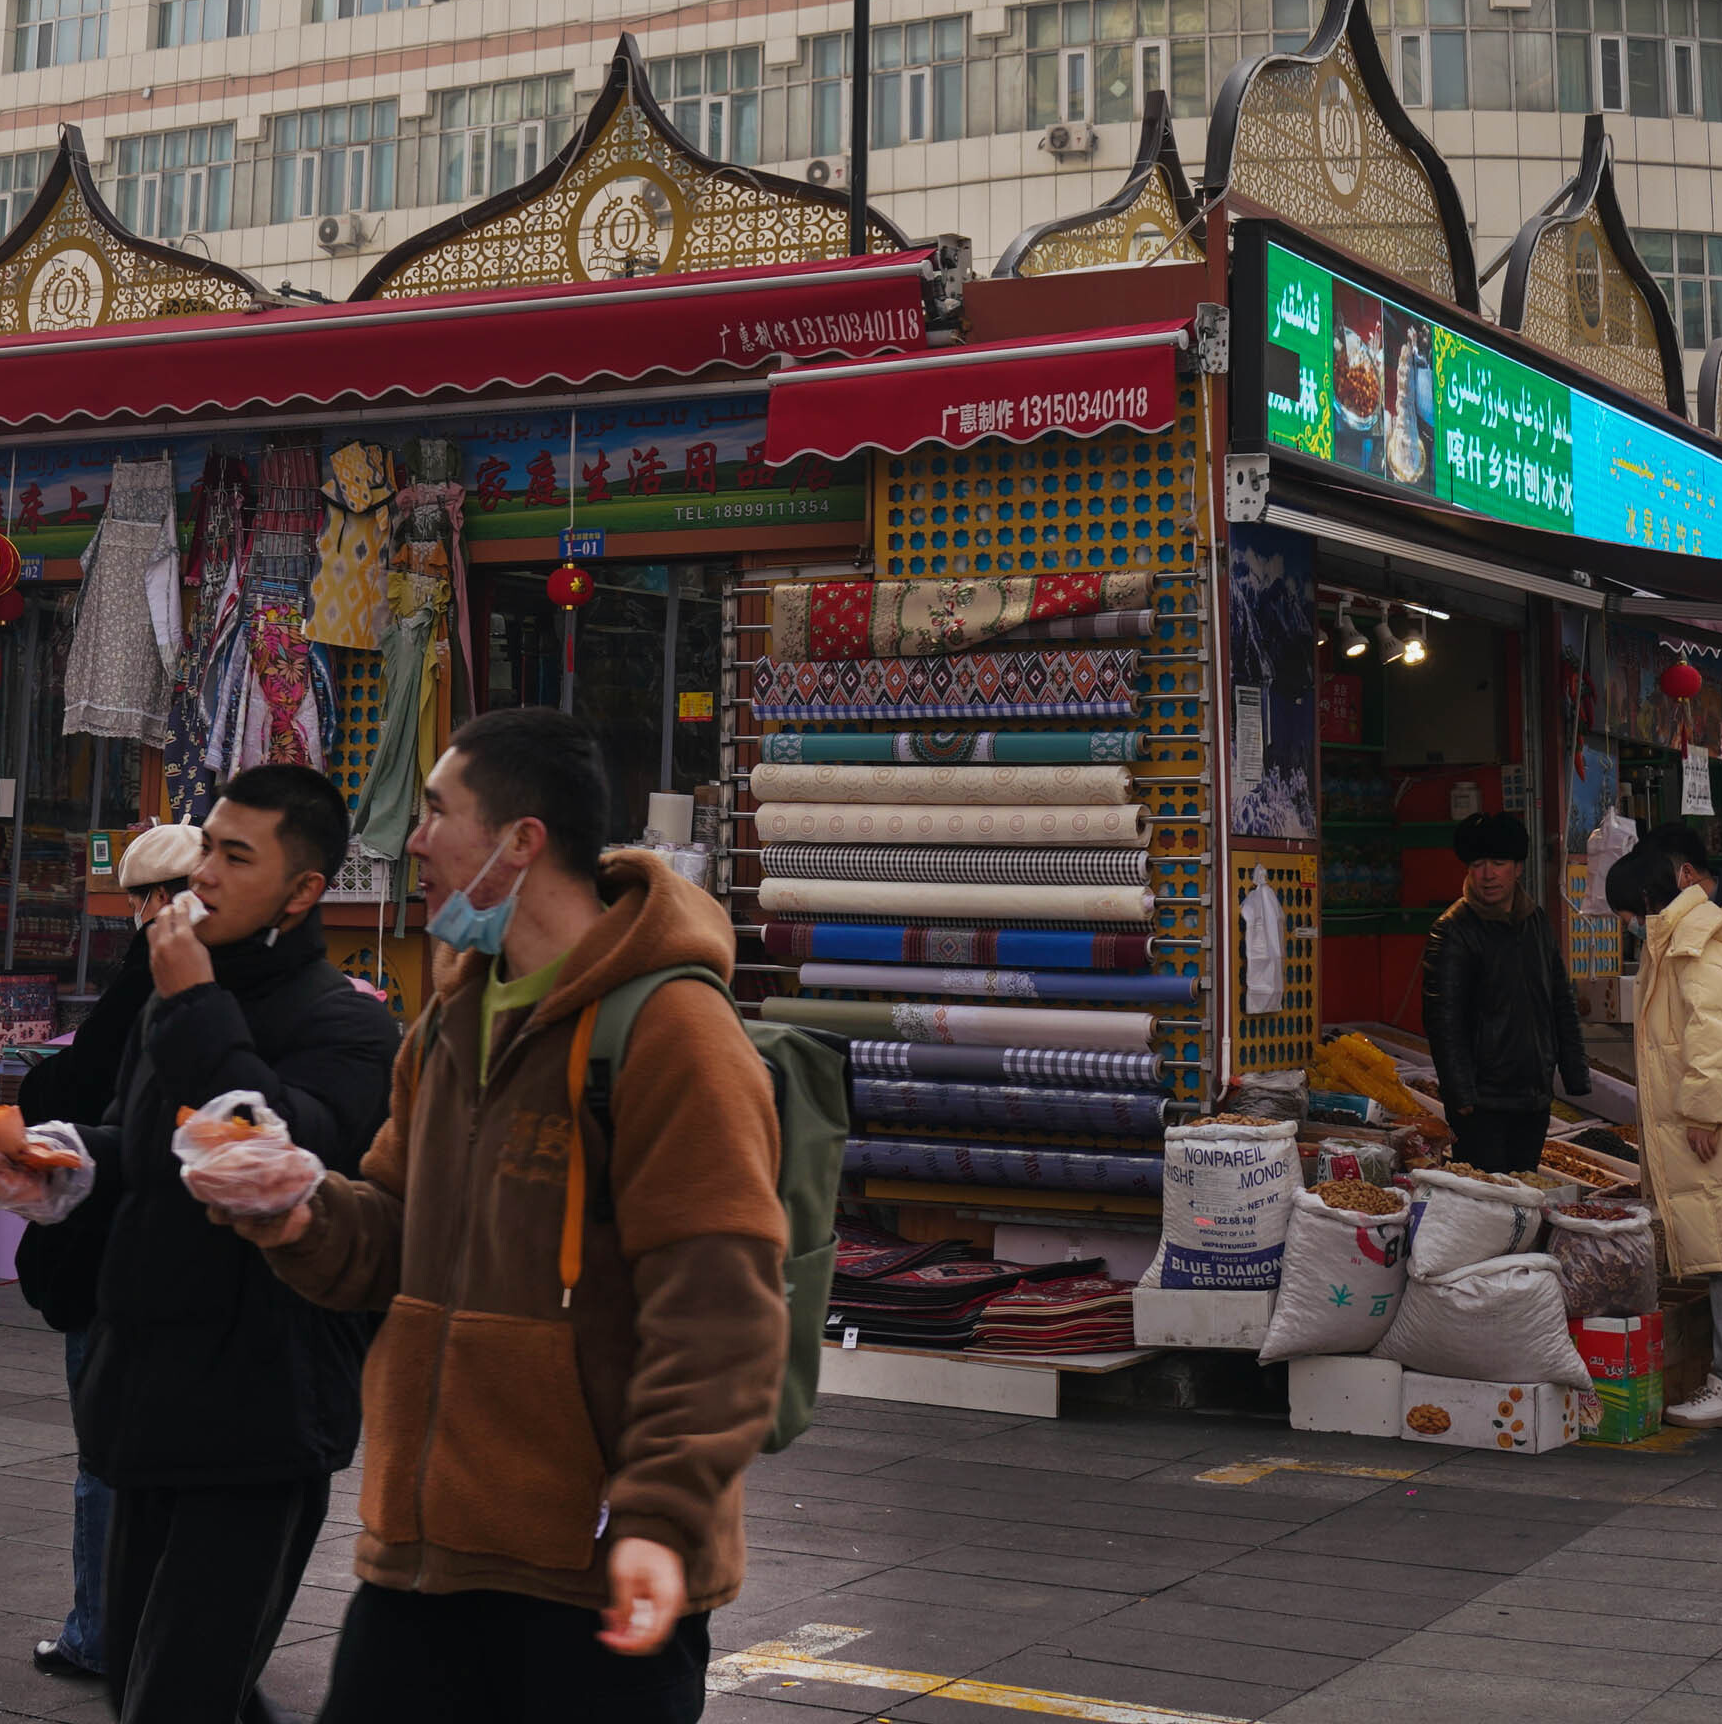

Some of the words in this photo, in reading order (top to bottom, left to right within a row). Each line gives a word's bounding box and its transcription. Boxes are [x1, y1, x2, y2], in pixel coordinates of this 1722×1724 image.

[941, 399, 1015, 436] 广惠制作
[1019, 386, 1148, 428] 13150340118
[674, 498, 831, 522] TEL:18999111354
[1184, 1146, 1267, 1168] NONPAREIL
[1237, 1158, 1291, 1190] MONDS
[1247, 1198, 1265, 1211] NET
[1171, 1256, 1213, 1275] BLUE
[1216, 1256, 1284, 1277] DIAMON
[1192, 1275, 1277, 1287] GROWERS
